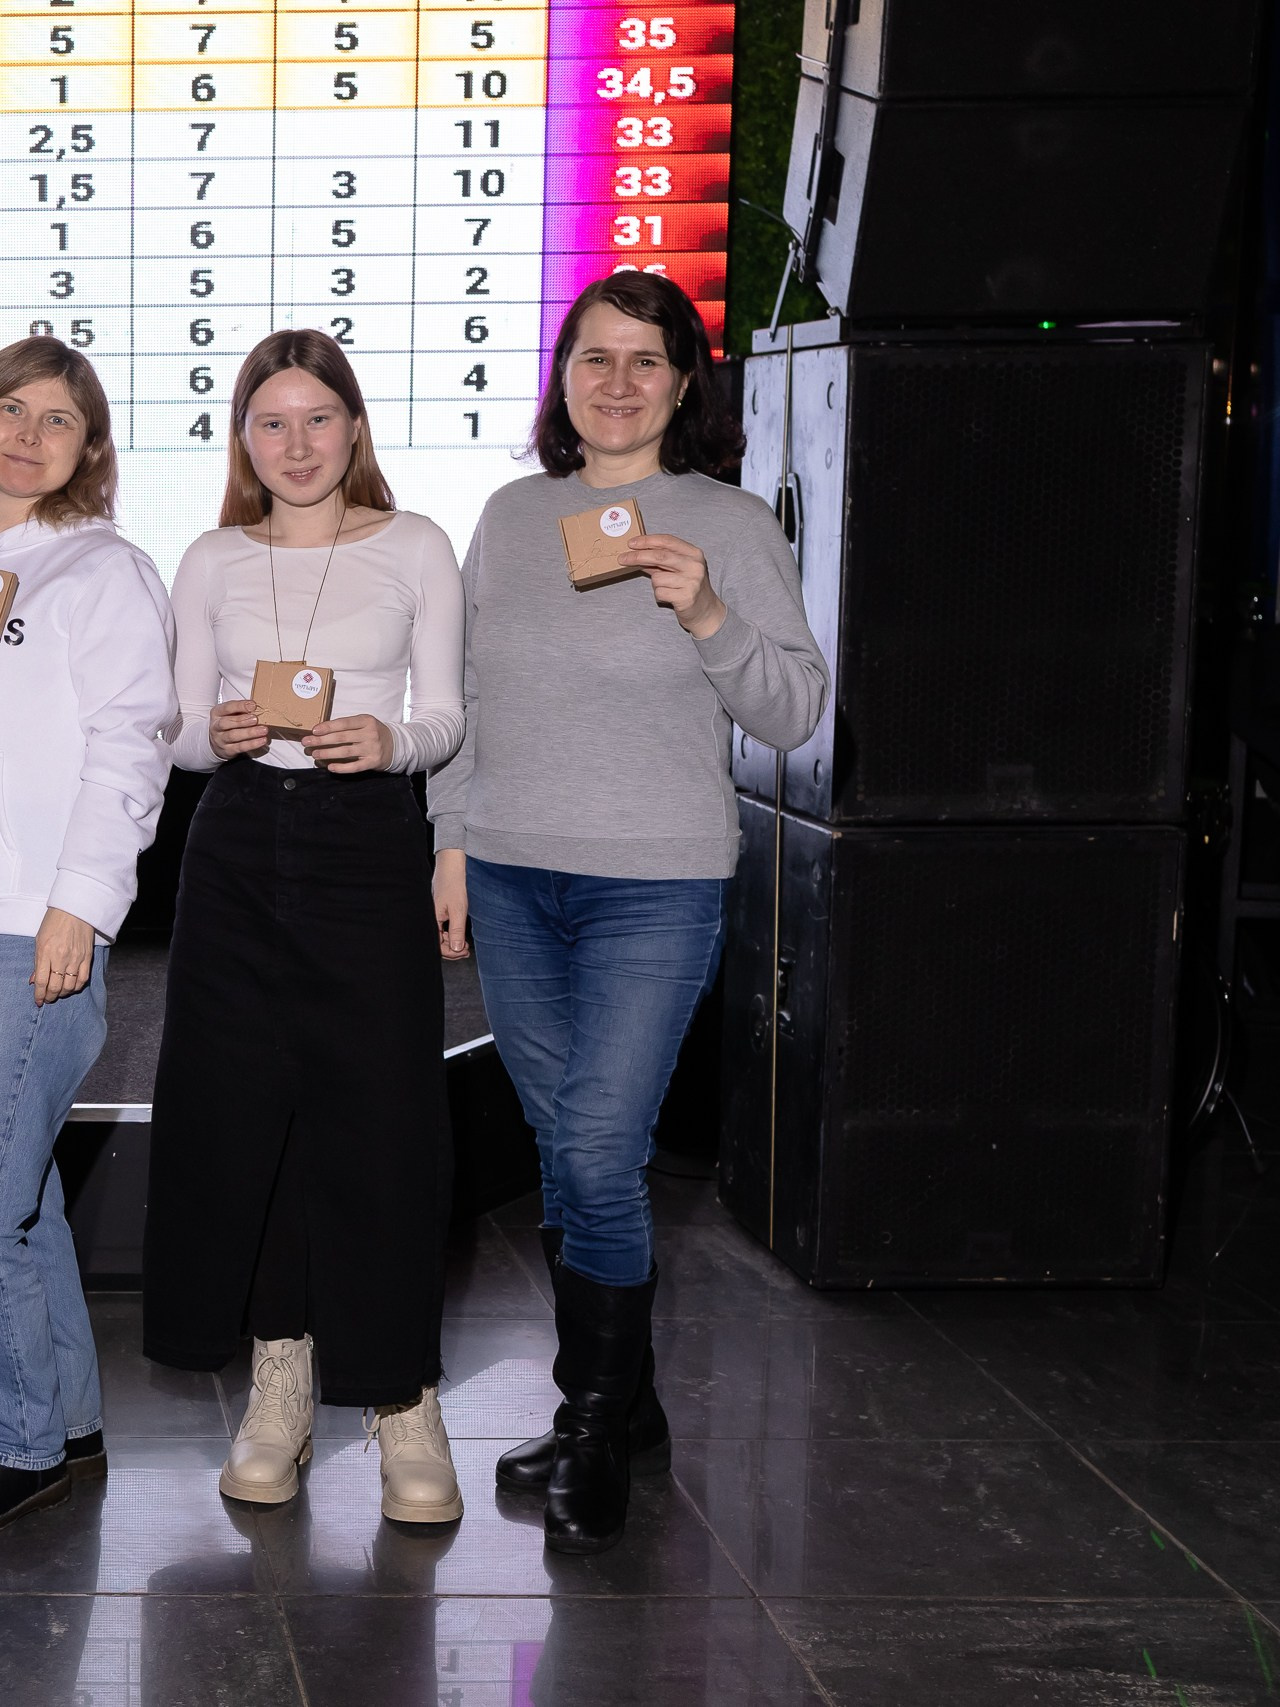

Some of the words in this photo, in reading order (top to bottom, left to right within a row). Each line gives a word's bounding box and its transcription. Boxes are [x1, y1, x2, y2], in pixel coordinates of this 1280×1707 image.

[50, 26, 75, 55] 5
[190, 24, 216, 53] 7
[334, 22, 359, 51] 5
[471, 21, 495, 49] 5
[620, 17, 676, 50] 35
[50, 76, 67, 104] 1
[191, 73, 216, 102] 6
[334, 71, 358, 101] 5
[457, 70, 507, 99] 10
[598, 66, 694, 104] 34,5
[29, 124, 94, 161] 2,5
[190, 123, 215, 151] 7
[456, 120, 500, 148] 11
[617, 116, 672, 148] 33
[31, 173, 94, 209] 1,5
[191, 172, 215, 200] 7
[332, 170, 356, 199] 3
[455, 169, 505, 198] 10
[616, 165, 671, 197] 33
[49, 223, 66, 251] 1
[190, 221, 215, 249] 6
[332, 219, 356, 248] 5
[466, 218, 490, 246] 7
[614, 215, 662, 246] 31
[50, 271, 74, 299] 3
[190, 270, 214, 298] 5
[331, 268, 355, 297] 3
[465, 267, 489, 295] 2
[189, 318, 215, 347] 6
[329, 316, 356, 346] 2
[464, 316, 489, 344] 6
[189, 366, 214, 394] 6
[463, 364, 488, 392] 4
[189, 413, 213, 441] 4
[462, 412, 479, 438] 1
